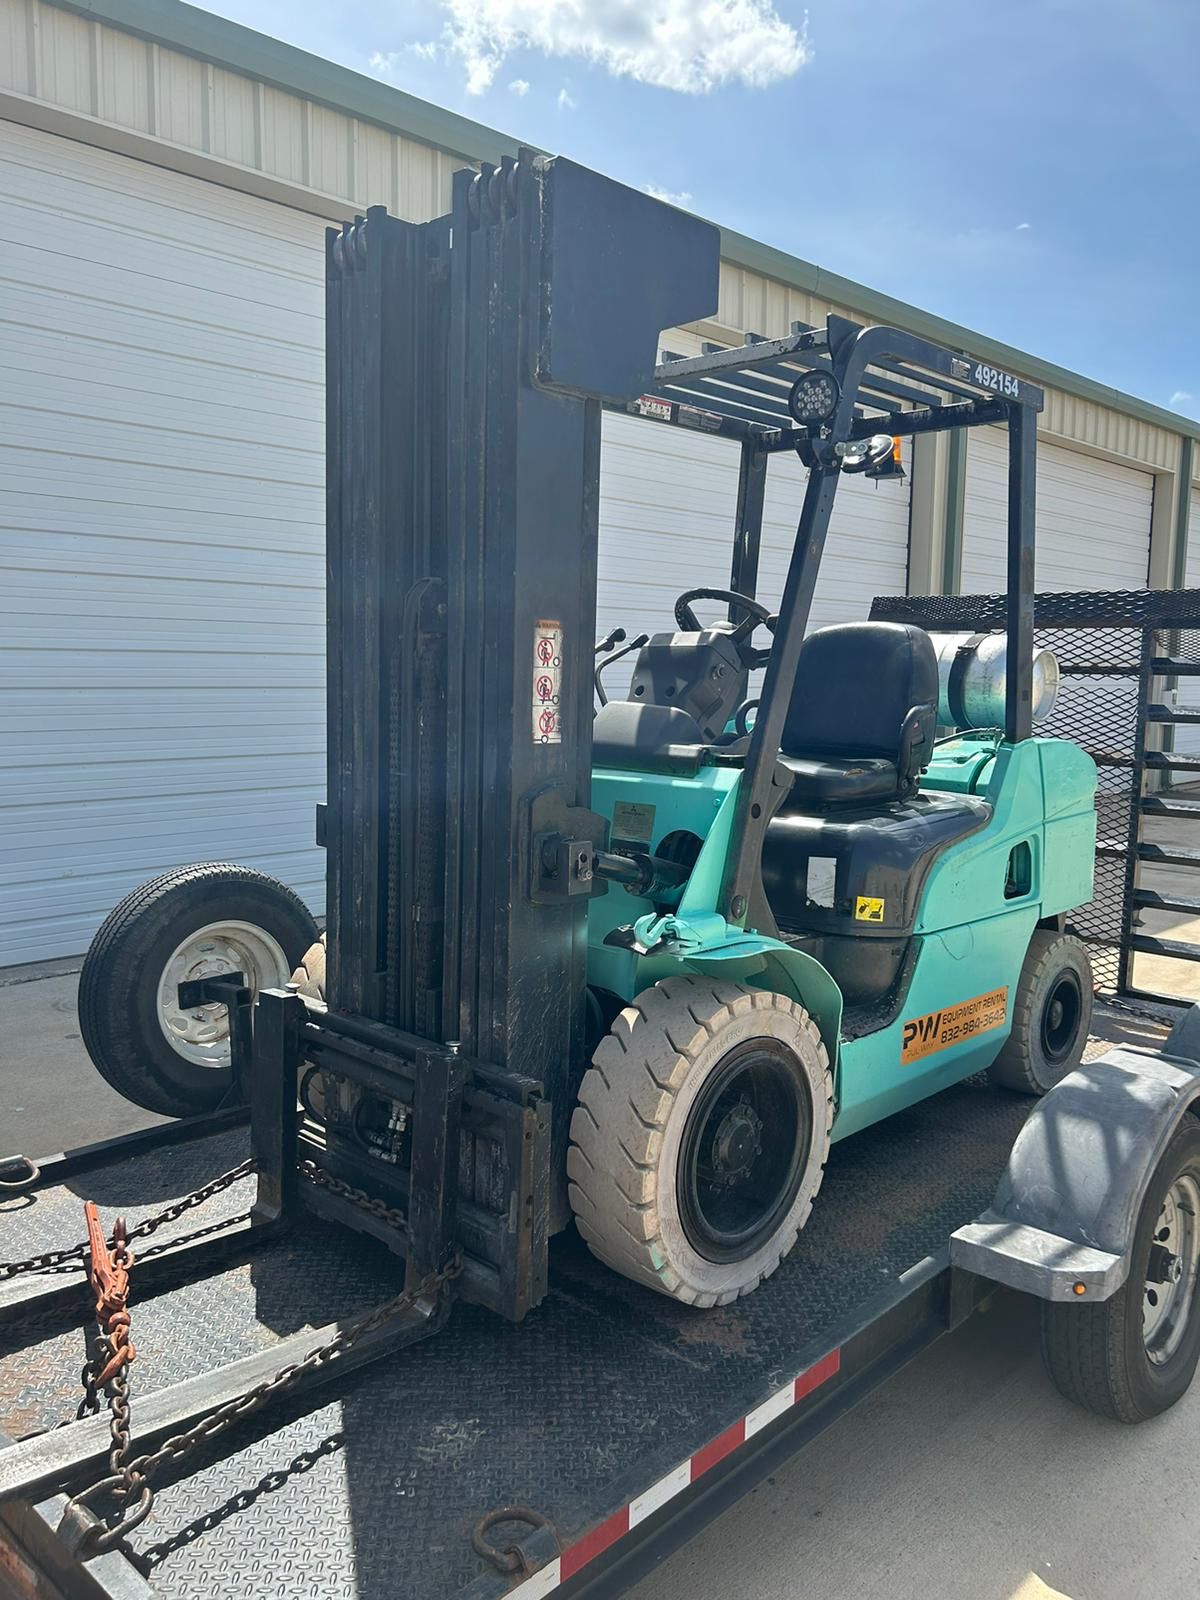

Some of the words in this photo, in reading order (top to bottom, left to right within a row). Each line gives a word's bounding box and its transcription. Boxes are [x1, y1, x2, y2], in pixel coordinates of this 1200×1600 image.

[975, 364, 1019, 397] 492154
[941, 1007, 1006, 1044] 832-984-3642
[942, 1000, 982, 1025] EQUIPMENT
[982, 992, 1006, 1010] RENTAL
[903, 1012, 942, 1050] PW
